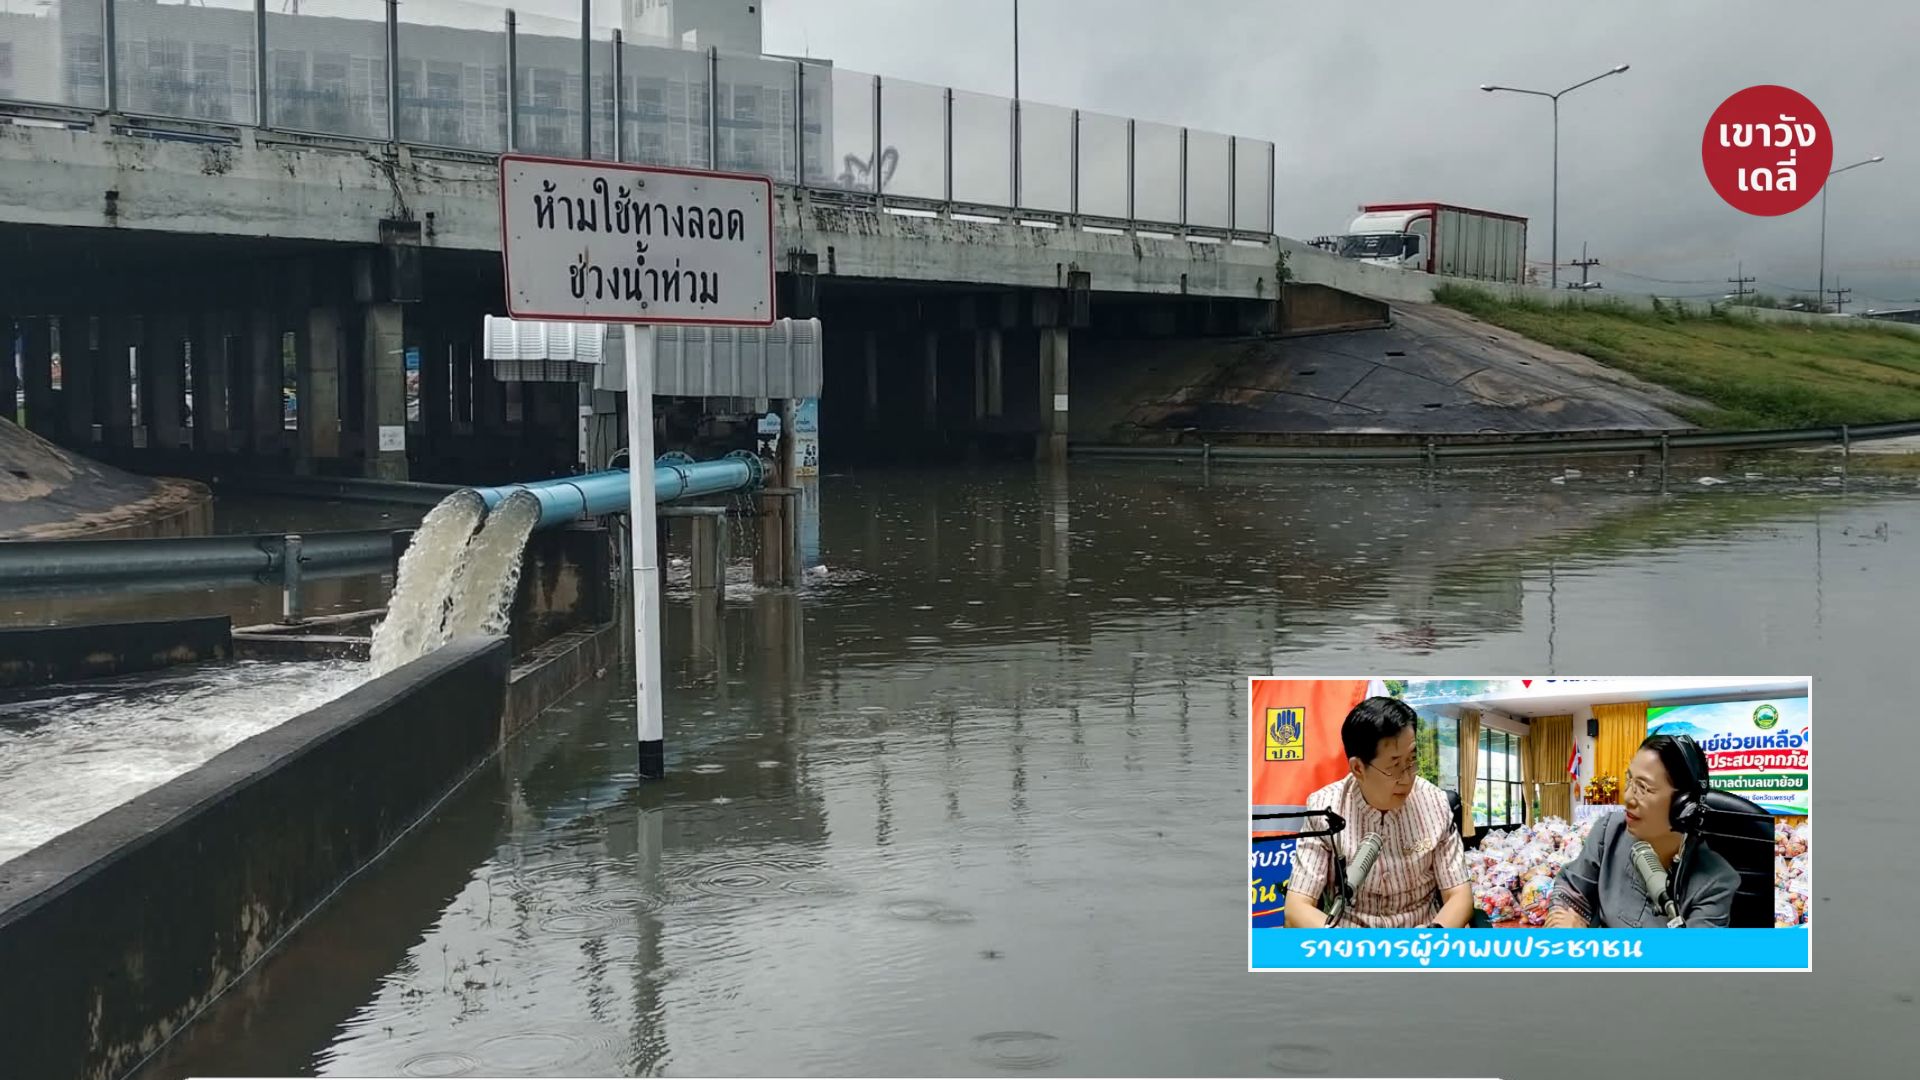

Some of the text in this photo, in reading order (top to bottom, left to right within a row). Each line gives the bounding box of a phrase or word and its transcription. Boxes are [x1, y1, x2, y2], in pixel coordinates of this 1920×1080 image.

[533, 177, 745, 242] ห้ามใช้ทางลอด
[569, 240, 719, 304] ช่วงน้ำท่วม
[1705, 750, 1808, 771] ประสบอุทกภัย
